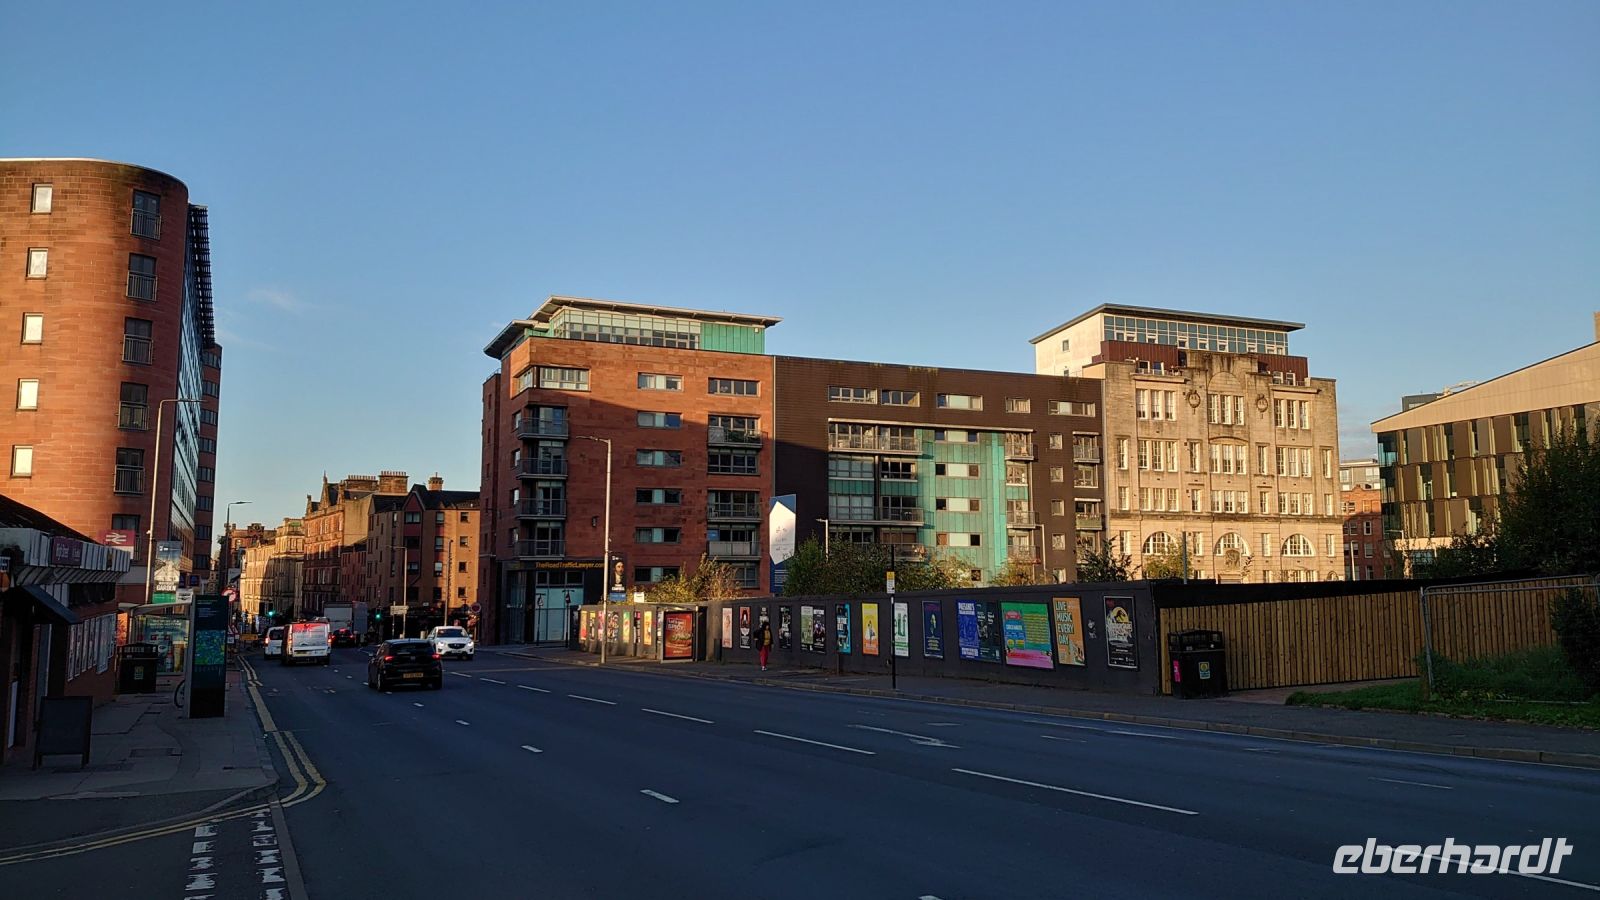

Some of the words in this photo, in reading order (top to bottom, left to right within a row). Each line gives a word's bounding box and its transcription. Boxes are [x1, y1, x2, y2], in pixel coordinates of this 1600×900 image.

[1055, 601, 1067, 611] LIVE
[1056, 611, 1072, 622] MUSIC
[1057, 623, 1074, 633] EVERY
[1058, 634, 1069, 644] DAY
